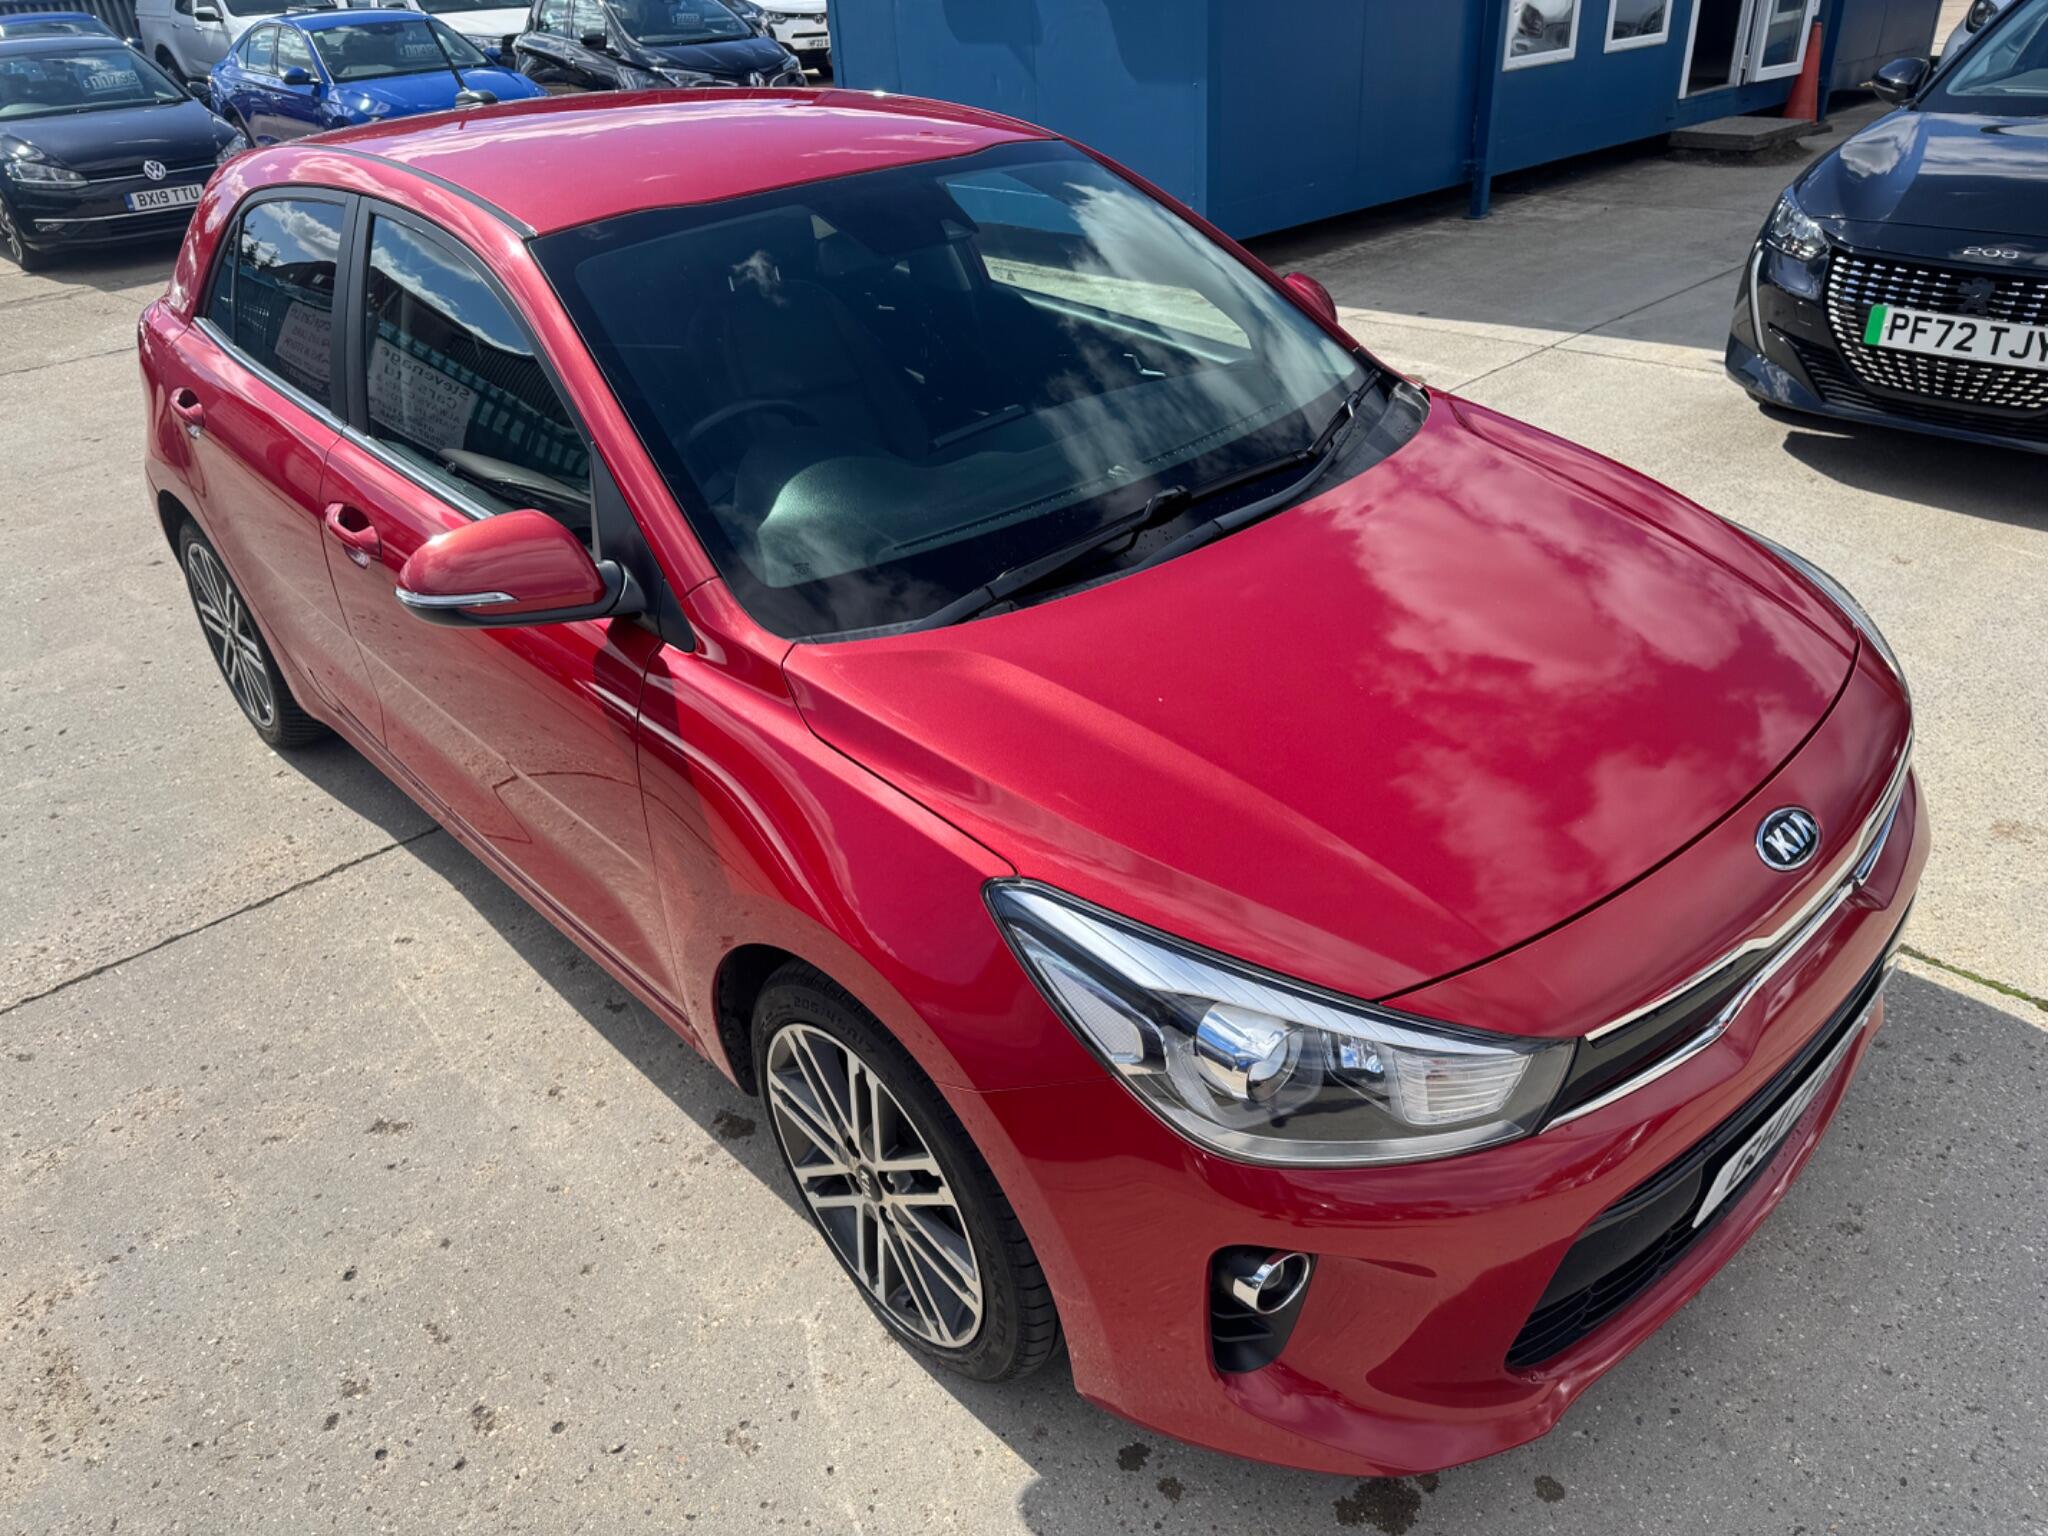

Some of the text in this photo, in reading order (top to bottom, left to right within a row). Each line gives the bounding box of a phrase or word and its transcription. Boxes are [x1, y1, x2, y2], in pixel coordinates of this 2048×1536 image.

[136, 186, 200, 207] BX19 TTU
[1962, 246, 2019, 259] 208
[1887, 312, 2048, 363] PF72 TJY
[1765, 812, 1817, 862] KIA
